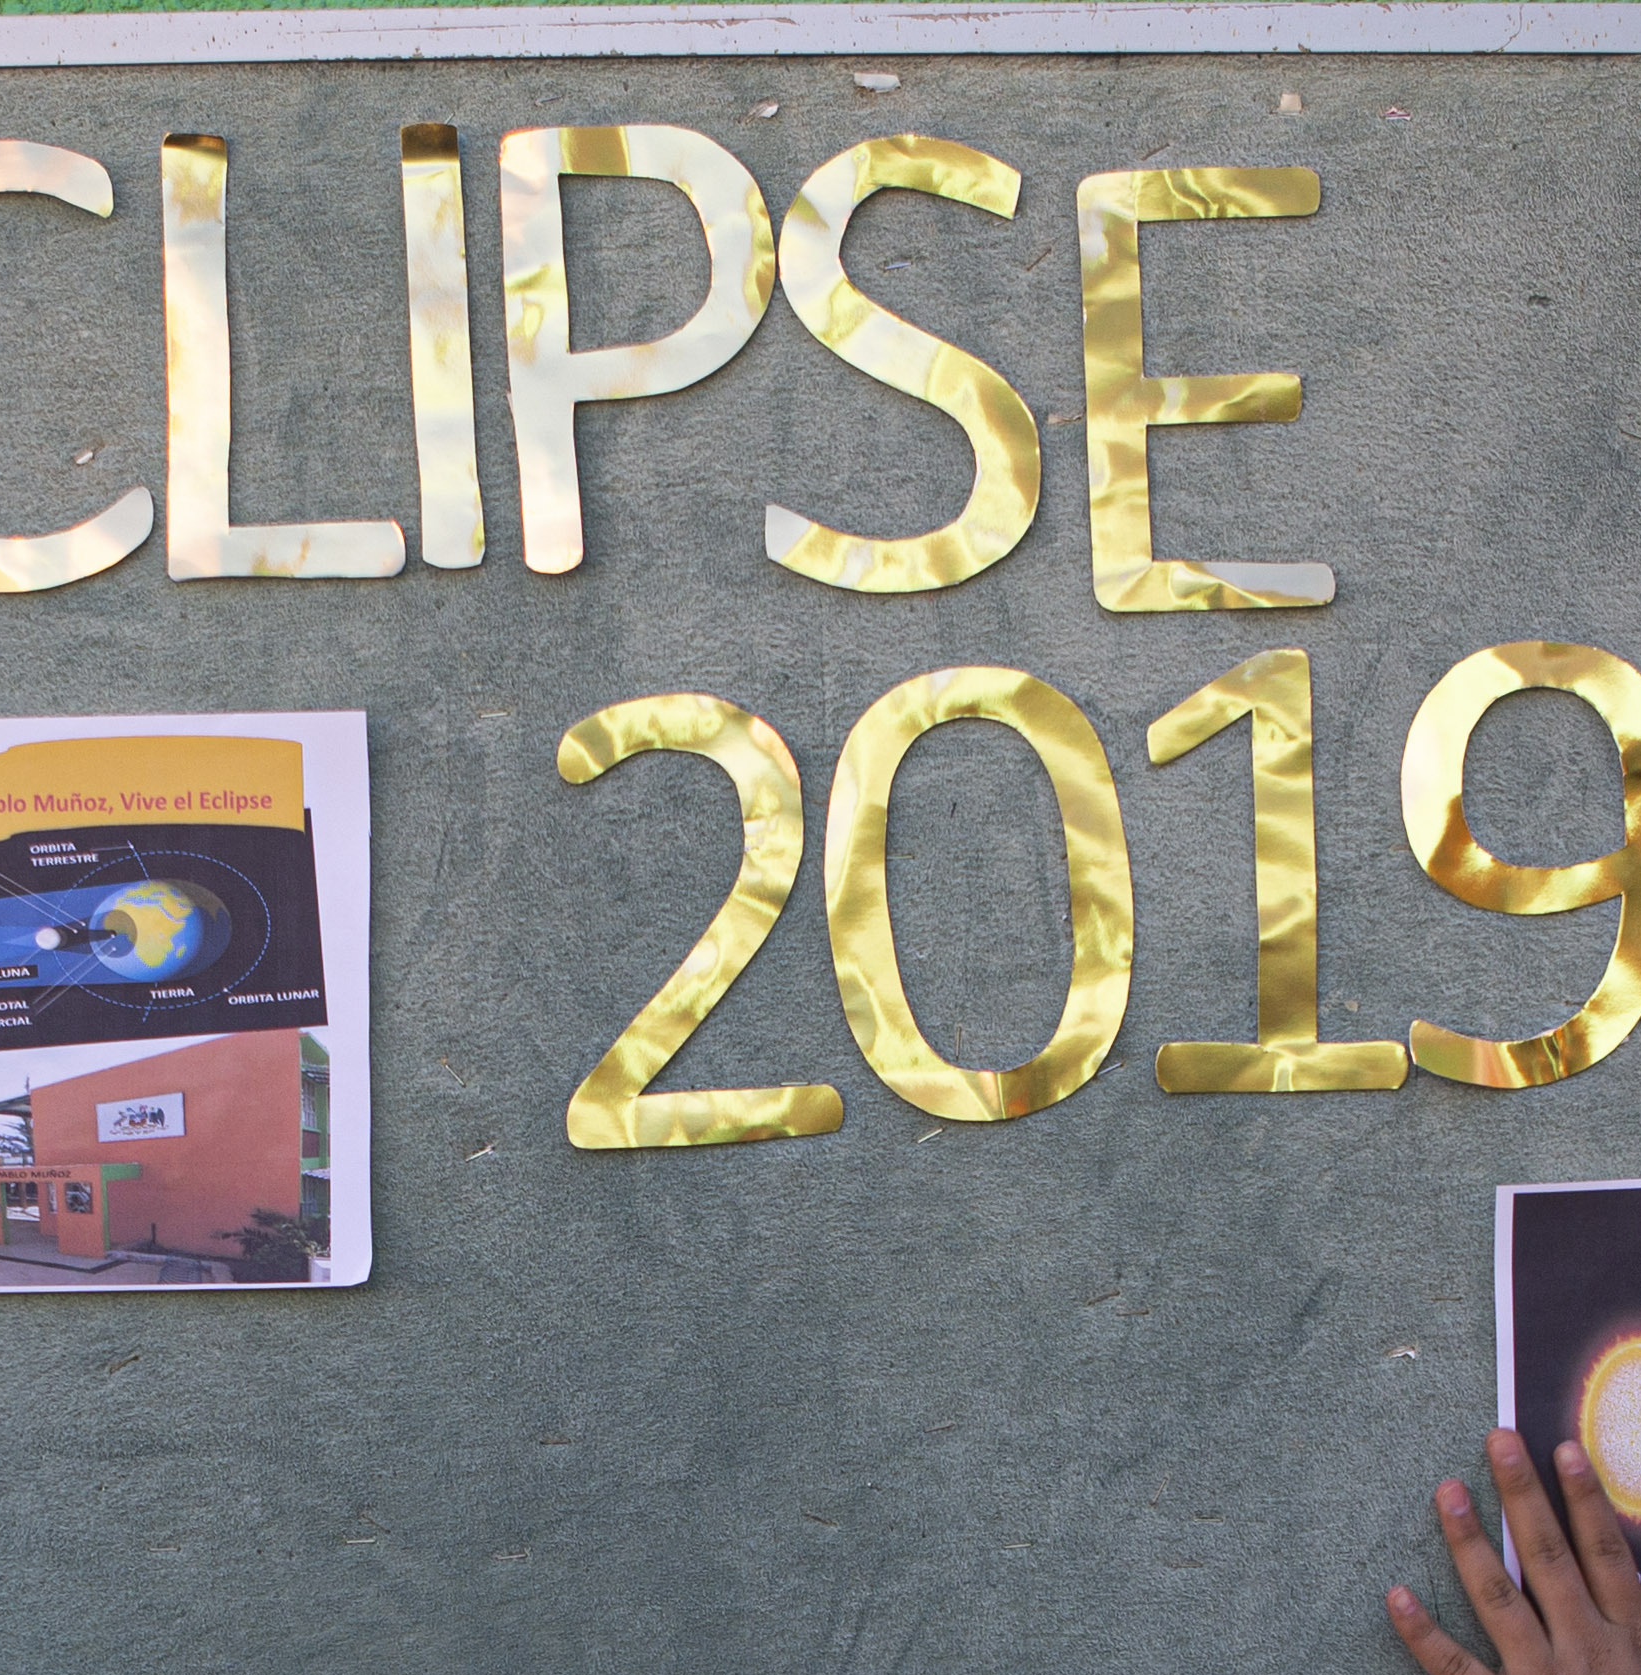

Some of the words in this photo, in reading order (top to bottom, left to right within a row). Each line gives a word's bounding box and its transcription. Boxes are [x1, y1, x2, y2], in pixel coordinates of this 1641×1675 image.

[33, 793, 114, 815] Muñoz,
[120, 791, 168, 812] Vive
[174, 791, 193, 811] el
[199, 790, 273, 814] Eclipse
[29, 842, 77, 855] ORBITA
[31, 853, 100, 868] TERRESTRE
[150, 987, 195, 1000] TIERRA
[227, 994, 274, 1006] ORBITA
[277, 989, 320, 1002] LUNAR
